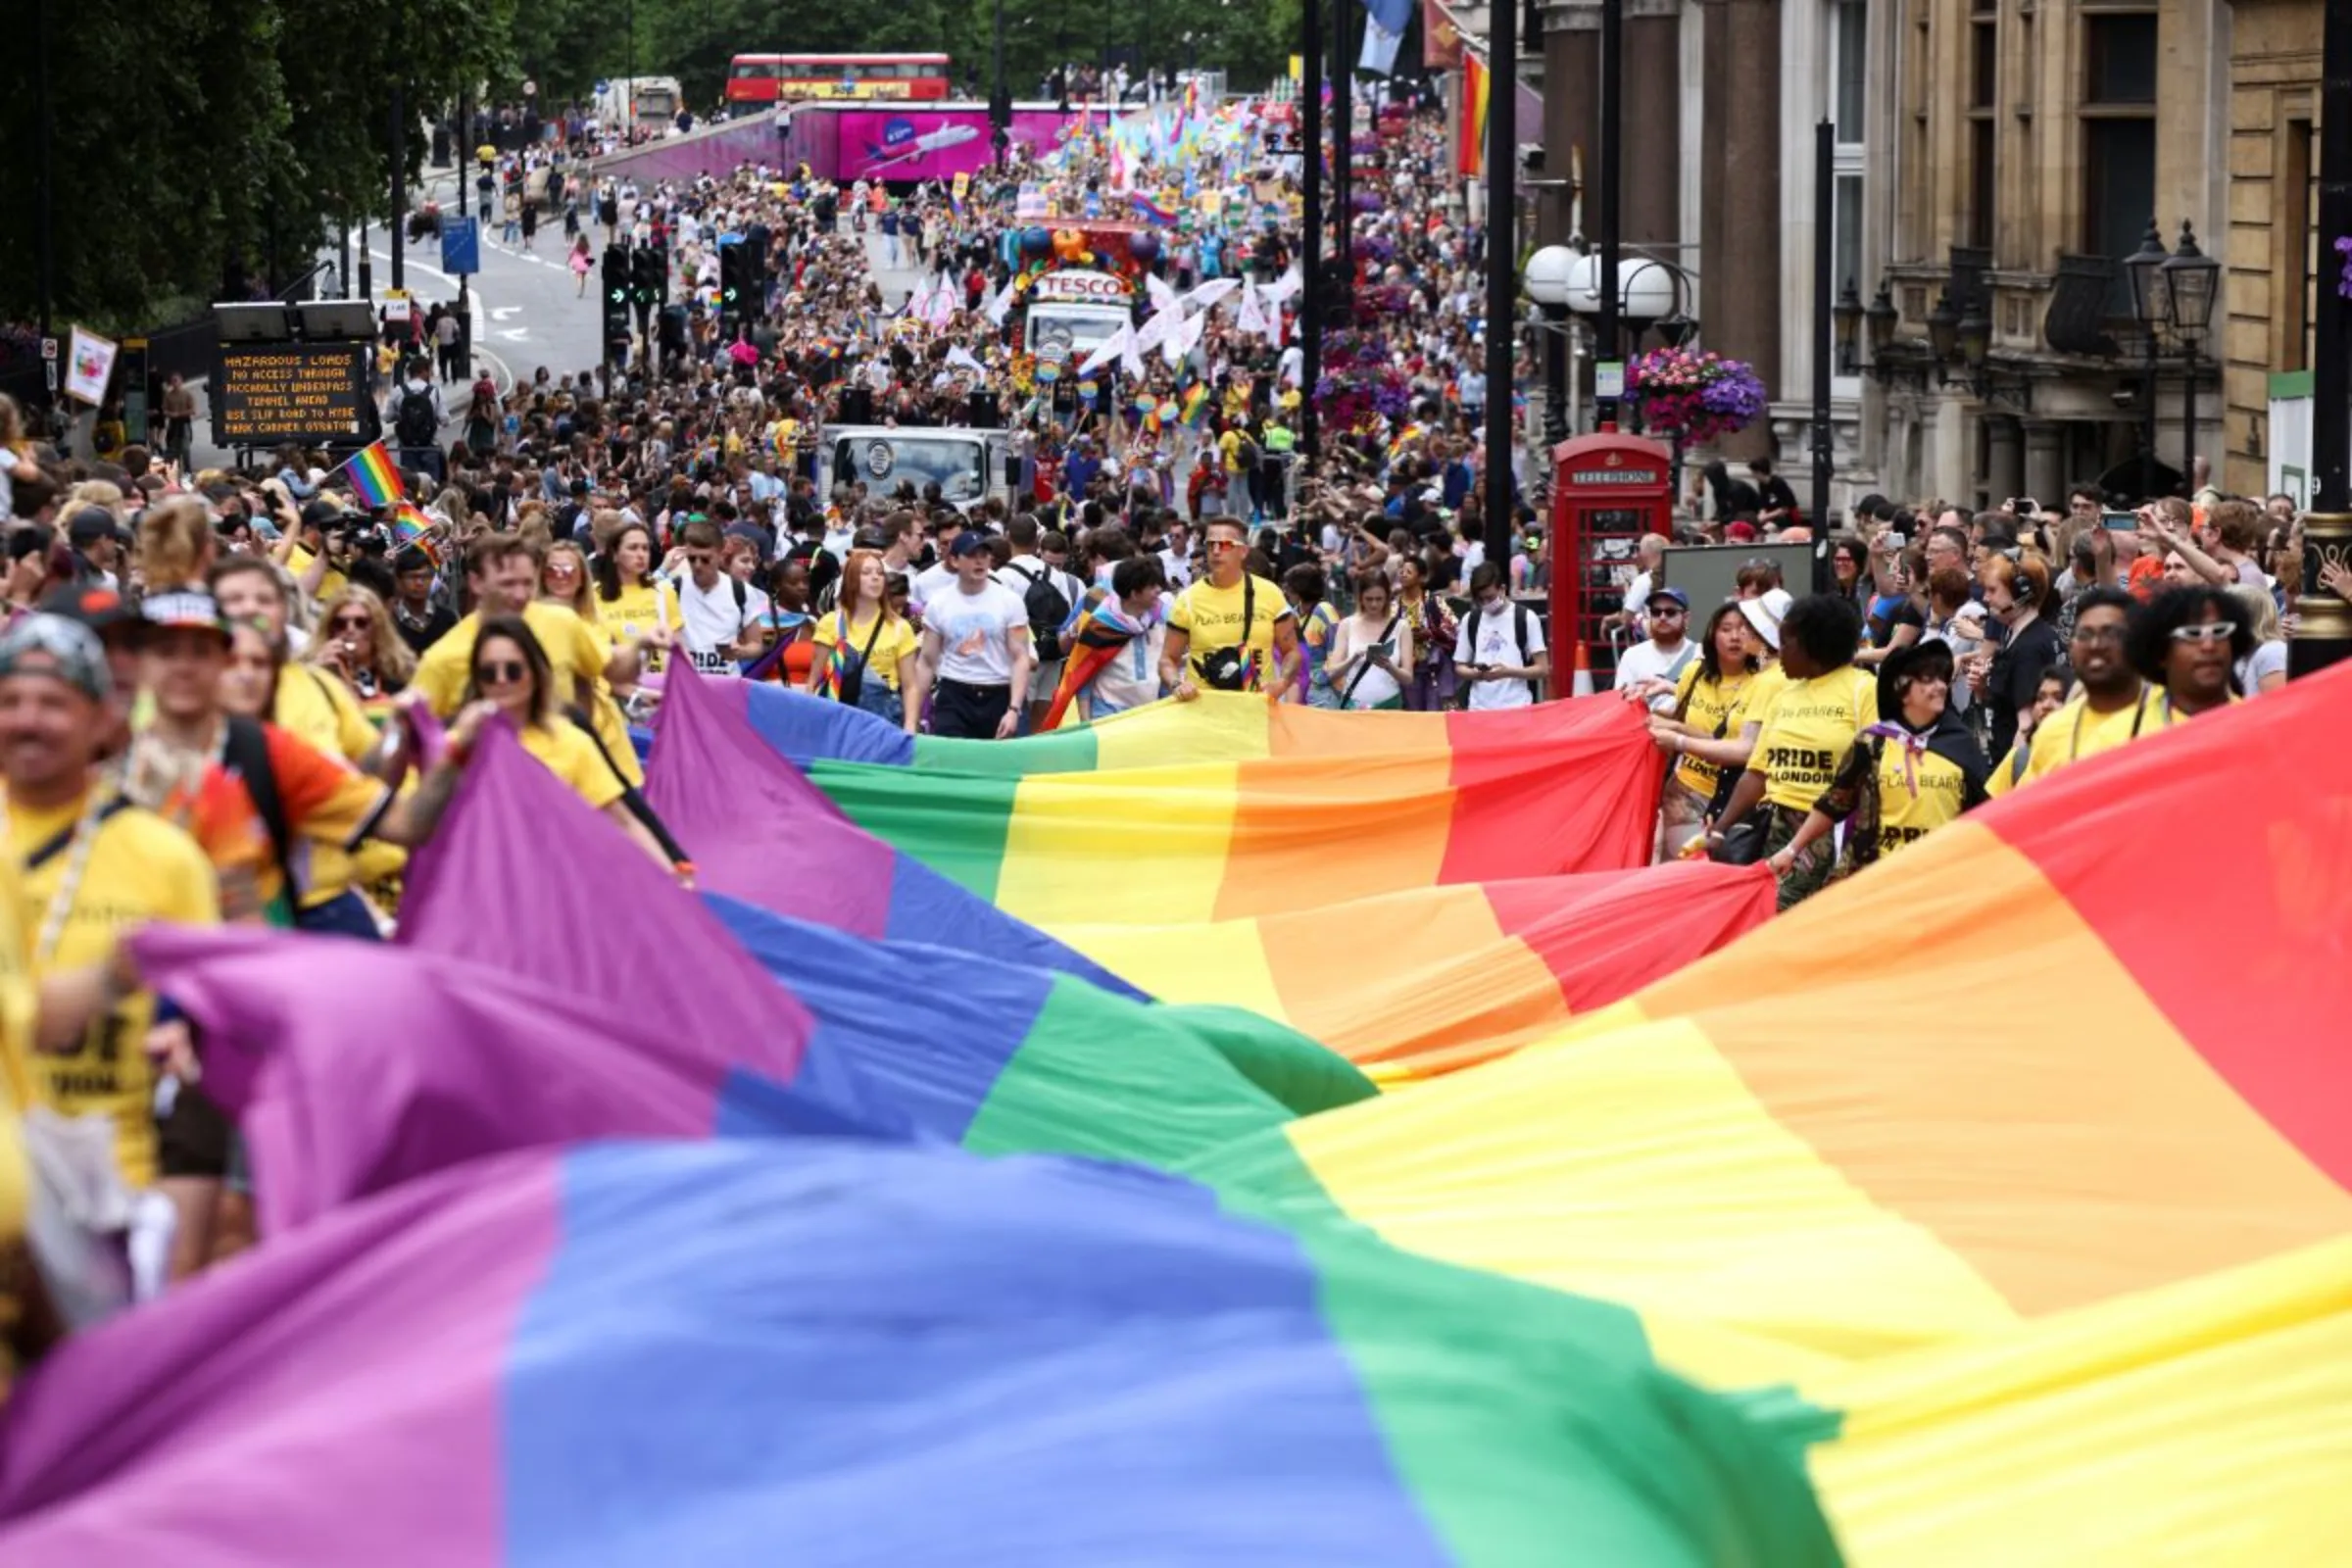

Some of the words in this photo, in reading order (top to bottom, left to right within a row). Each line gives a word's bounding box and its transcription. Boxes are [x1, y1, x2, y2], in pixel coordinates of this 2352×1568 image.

[1046, 277, 1120, 295] TESCO
[224, 356, 302, 368] HAZARDOUS
[311, 354, 352, 366] LOADS
[232, 369, 248, 380] NO
[252, 368, 292, 379] ACCESS
[298, 368, 346, 379] THROUGH
[226, 382, 287, 394] PICCADILLY
[291, 381, 354, 392] UNDERPASS
[247, 395, 290, 407] TUNNEL
[295, 394, 328, 406] AHEAD
[225, 410, 246, 420] USE
[251, 409, 273, 419] SLIP
[279, 409, 306, 418] ROAD
[312, 408, 324, 418] TO
[328, 407, 356, 418] HYDE
[224, 421, 254, 434] PARK
[258, 421, 301, 433] CORNER
[1574, 471, 1656, 484] TELEPHONE
[1775, 770, 1834, 784] LONDON
